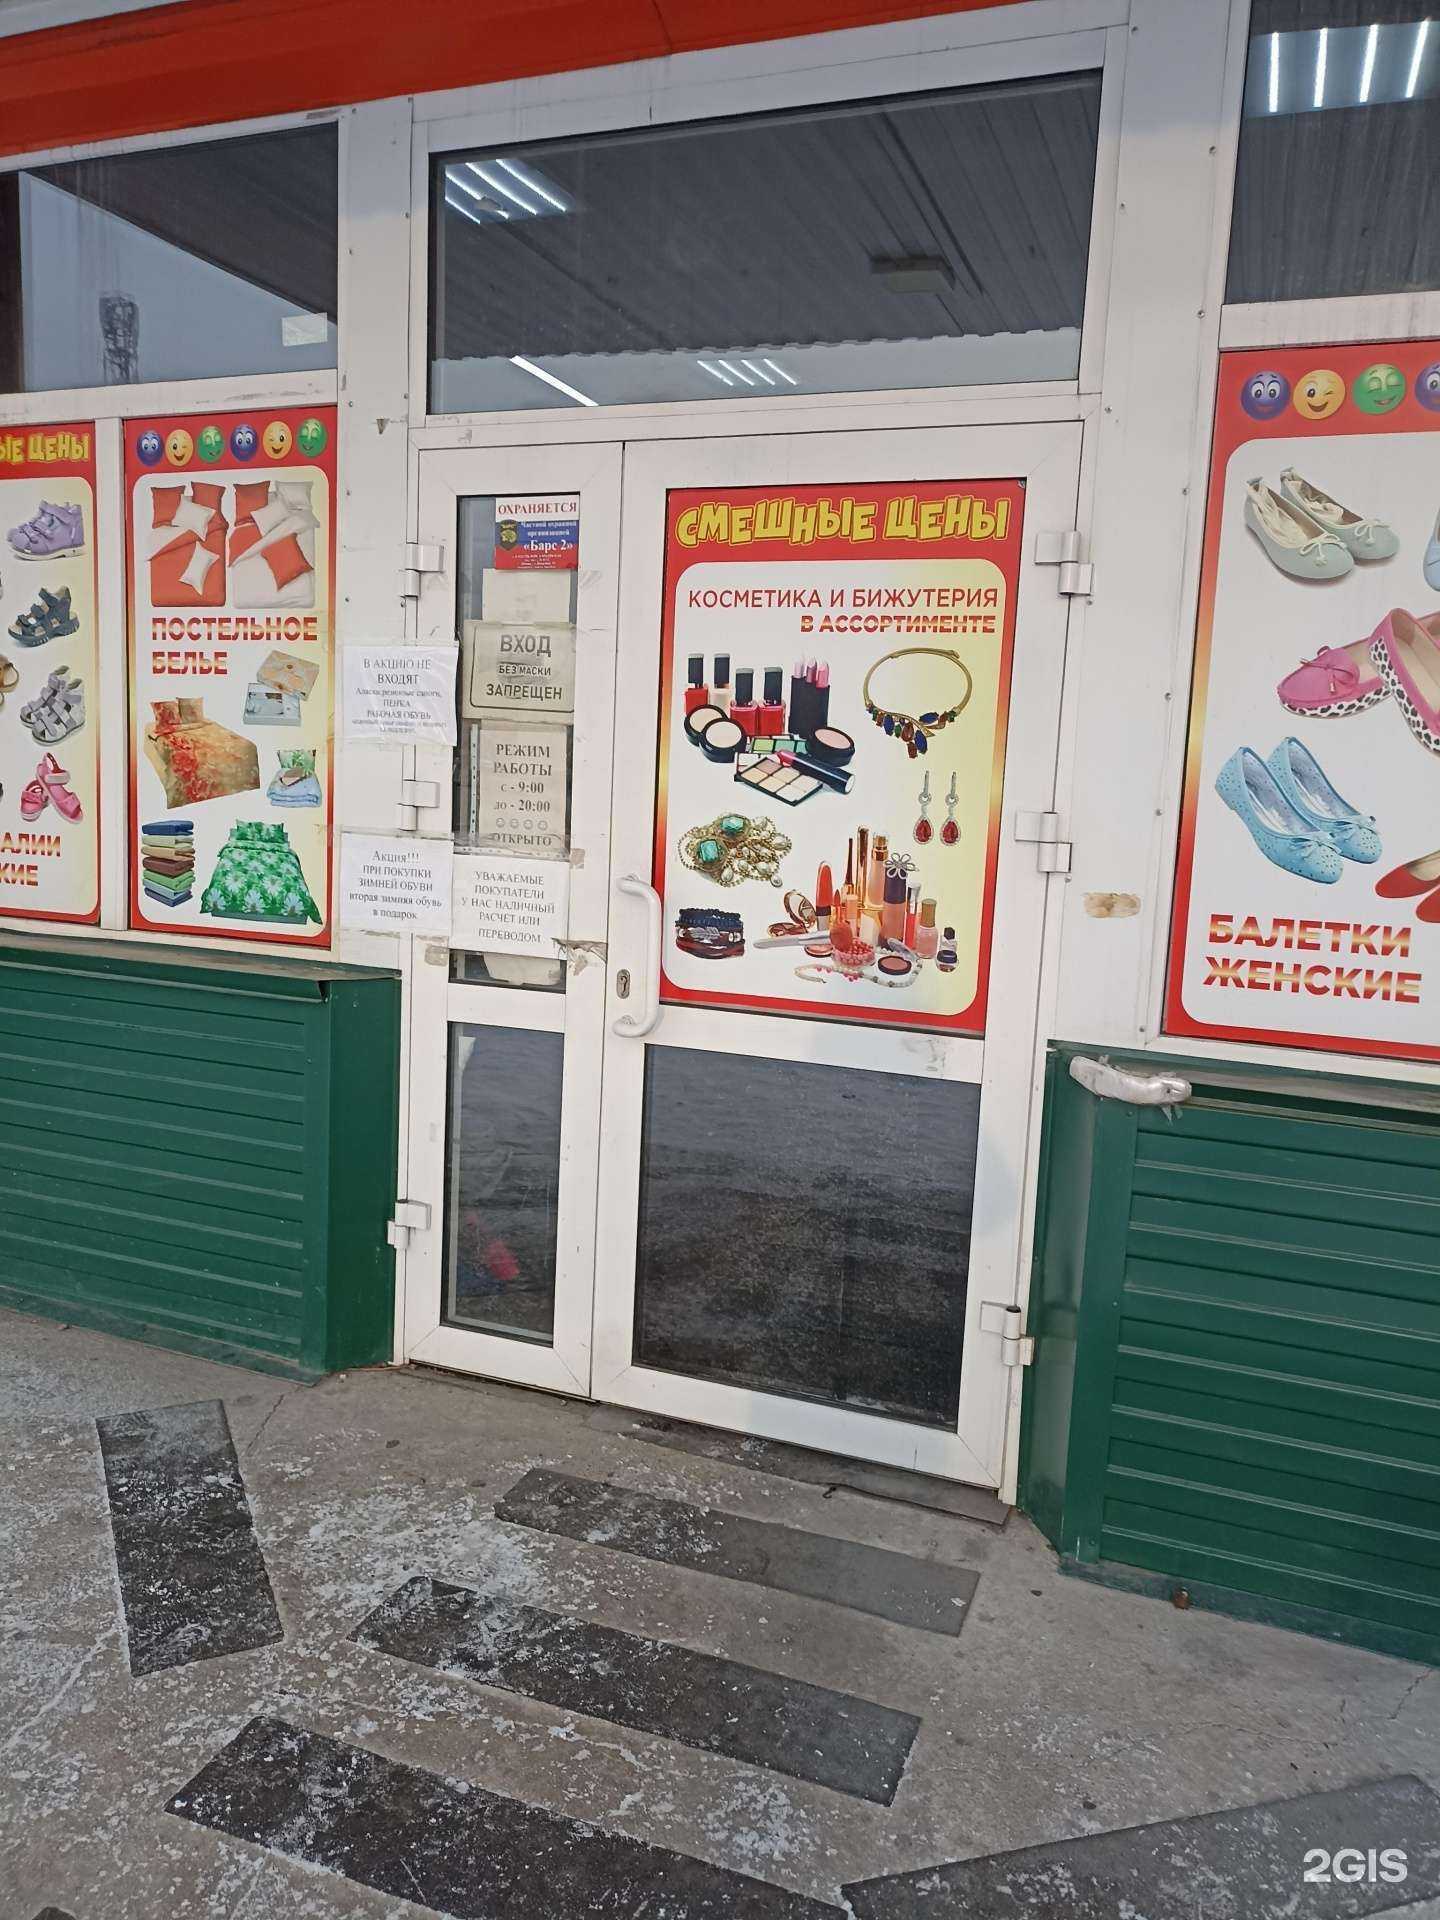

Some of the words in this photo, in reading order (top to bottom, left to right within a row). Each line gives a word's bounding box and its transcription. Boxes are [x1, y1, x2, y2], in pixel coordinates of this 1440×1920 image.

[28, 432, 90, 463] ЦЕНЫ
[498, 502, 577, 515] ОХРАНЯЕТСЯ
[676, 498, 877, 548] СМЕШНЫЕ
[883, 495, 1011, 542] ЦЕНЫ
[689, 589, 822, 608] КОСМЕТИКА
[831, 589, 844, 608] И
[853, 588, 998, 608] БИЖУТЕРИЯ
[152, 617, 318, 641] ПОСТЕЛЬНОЕ
[800, 615, 815, 633] В
[818, 614, 996, 634] АССОРТИМЕНТЕ
[500, 634, 551, 657] ВХОД
[152, 651, 228, 675] БЕЛЬЕ
[364, 658, 370, 669] В
[373, 659, 414, 671] АКЦИЮ
[417, 659, 432, 670] НЕ
[499, 665, 517, 675] БЕЗ
[520, 666, 551, 676] МАСКИ
[377, 674, 419, 685] ВХОДЯТ
[486, 683, 562, 701] ЗАПРЕЩЕН
[496, 744, 550, 758] РЕЖИМ
[494, 762, 552, 776] РАБОТЫ
[518, 782, 544, 793] 9:00
[518, 799, 551, 812] 20:00
[494, 833, 552, 847] ОТКРЫТО
[372, 850, 420, 863] Акция!!!
[363, 864, 381, 875] ПРИ
[384, 866, 432, 878] ПОКУПКИ
[474, 871, 544, 885] УВАЖАЕМЫЕ
[359, 878, 398, 890] ЗИМНЕЙ
[400, 881, 433, 892] ОБУВИ
[475, 884, 544, 899] ПОКУПАТЕЛИ
[349, 893, 378, 903] вторая
[416, 896, 442, 908] обувь
[461, 897, 469, 906] У
[471, 898, 492, 909] НАС
[495, 899, 555, 914] НАЛИЧНЫЙ
[380, 910, 417, 920] подарок
[519, 915, 540, 927] ИЛИ
[479, 928, 541, 943] ПЕРЕВОДОМ
[1208, 914, 1411, 957] БАЛЕТКИ
[1203, 956, 1422, 1004] ЖЕНСКИЕ
